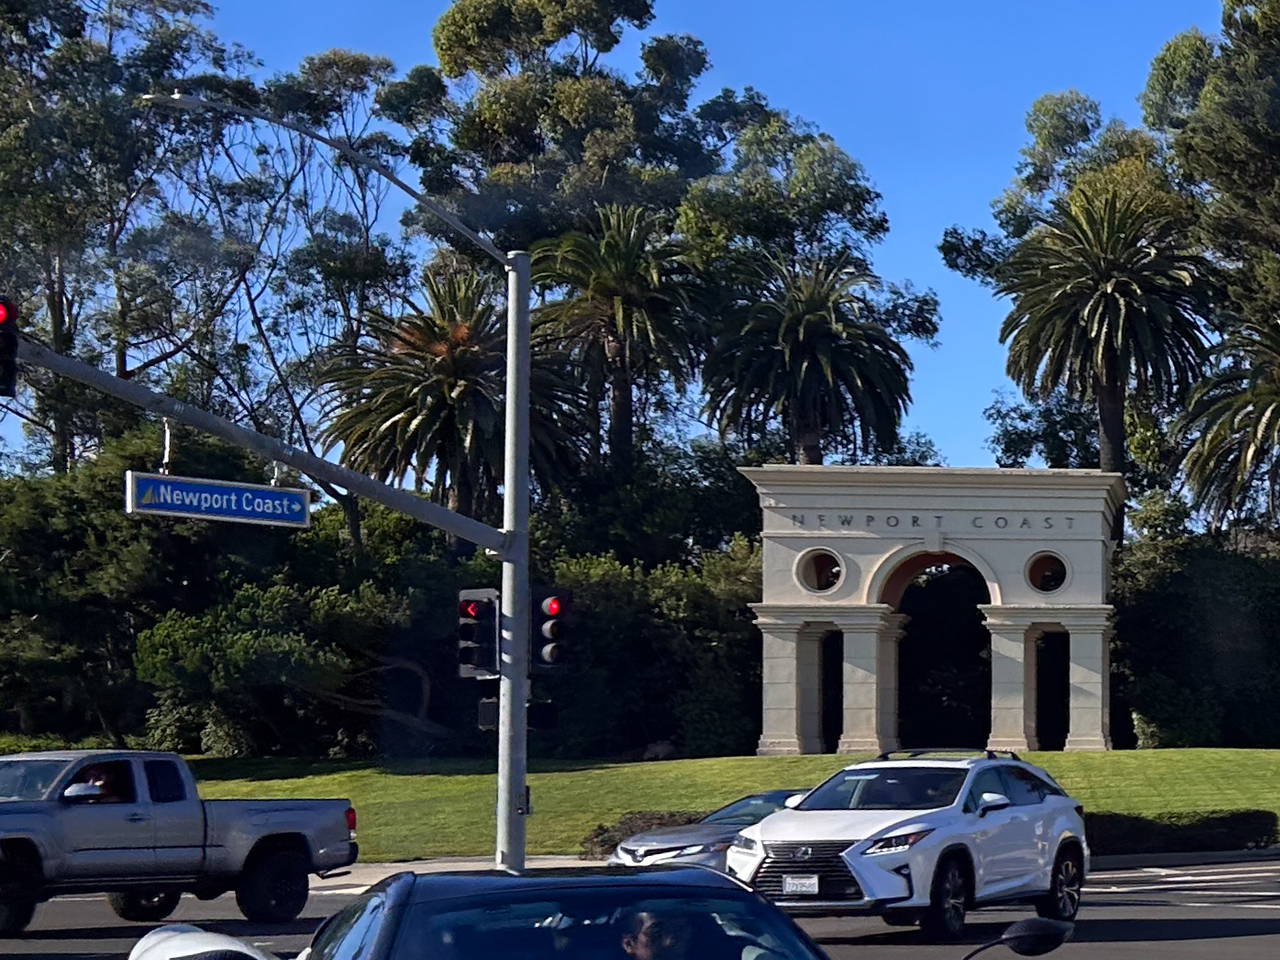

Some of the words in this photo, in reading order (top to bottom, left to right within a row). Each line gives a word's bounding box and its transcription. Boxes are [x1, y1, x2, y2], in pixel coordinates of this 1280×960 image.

[159, 484, 237, 510] Newport
[242, 492, 290, 514] Coast
[791, 514, 944, 529] NEWPORT
[970, 516, 1076, 530] COAST
